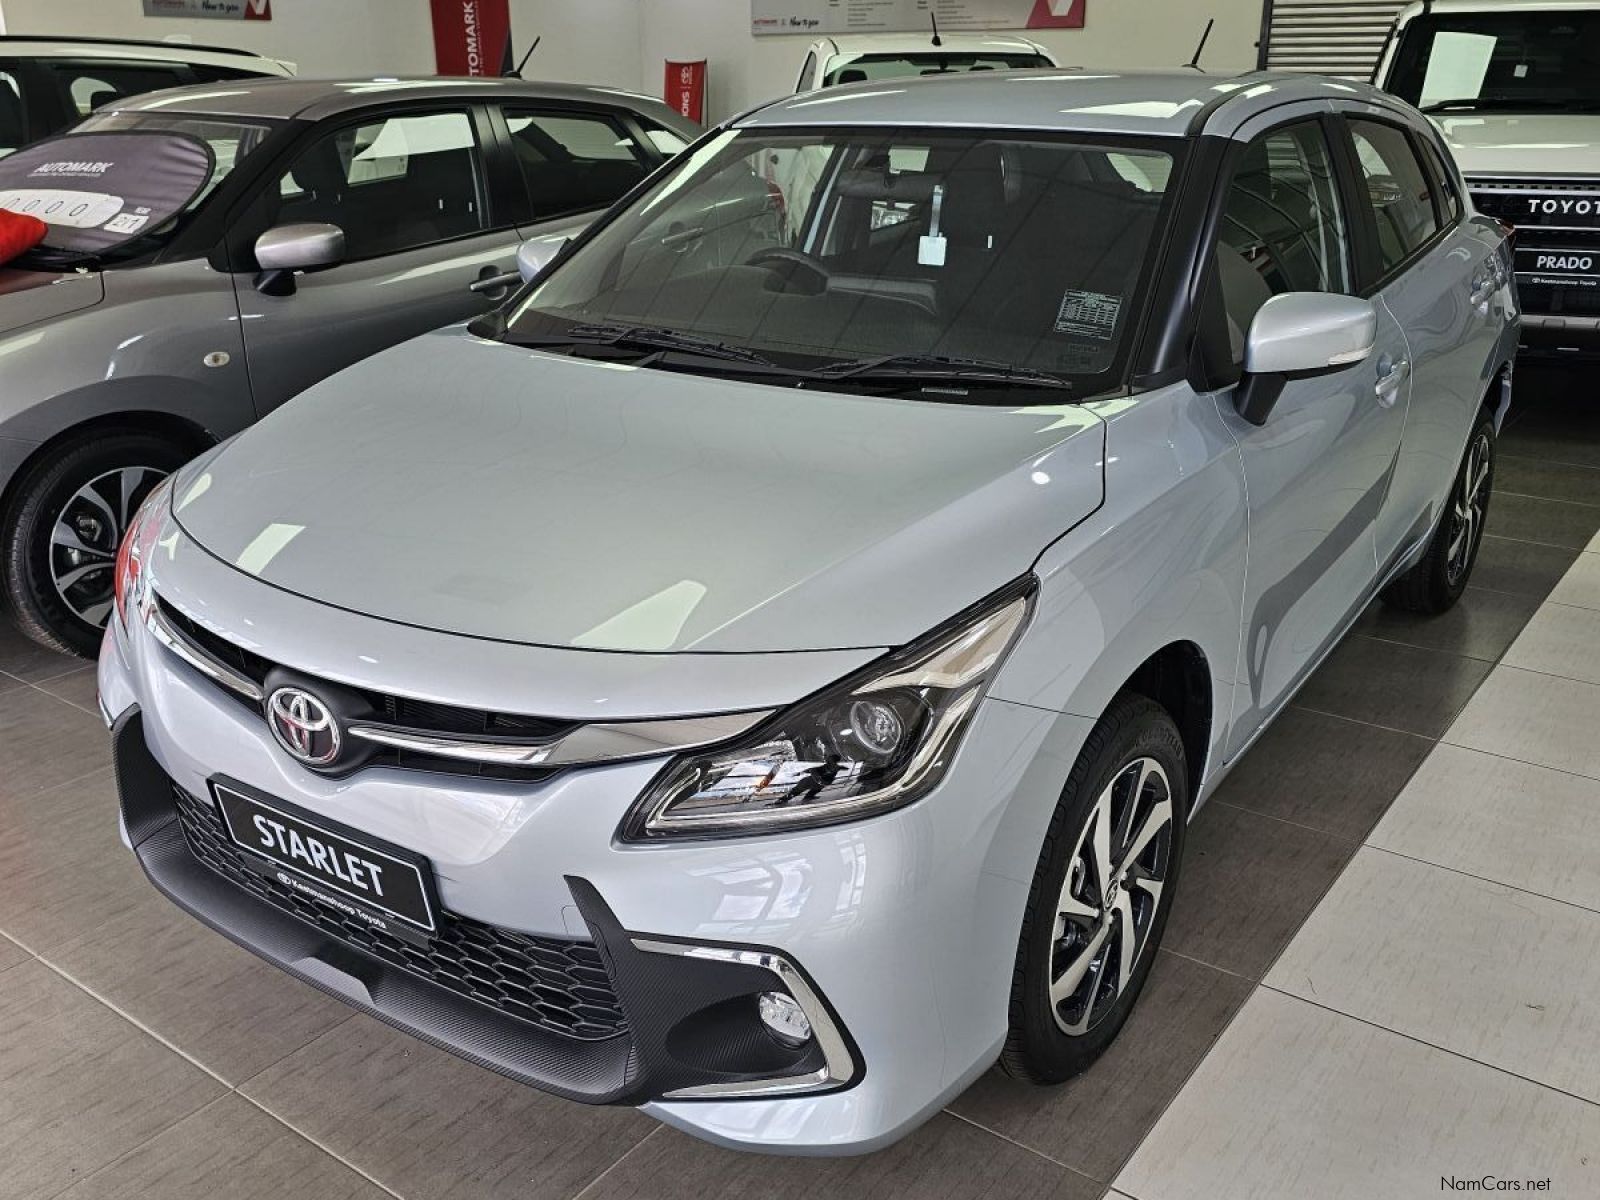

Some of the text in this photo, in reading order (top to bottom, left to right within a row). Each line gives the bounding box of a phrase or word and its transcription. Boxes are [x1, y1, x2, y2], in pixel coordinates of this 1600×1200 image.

[33, 162, 115, 173] AUTOMARK
[1536, 255, 1593, 270] PRADO
[252, 814, 384, 896] STARLET
[354, 907, 387, 929] Toyota
